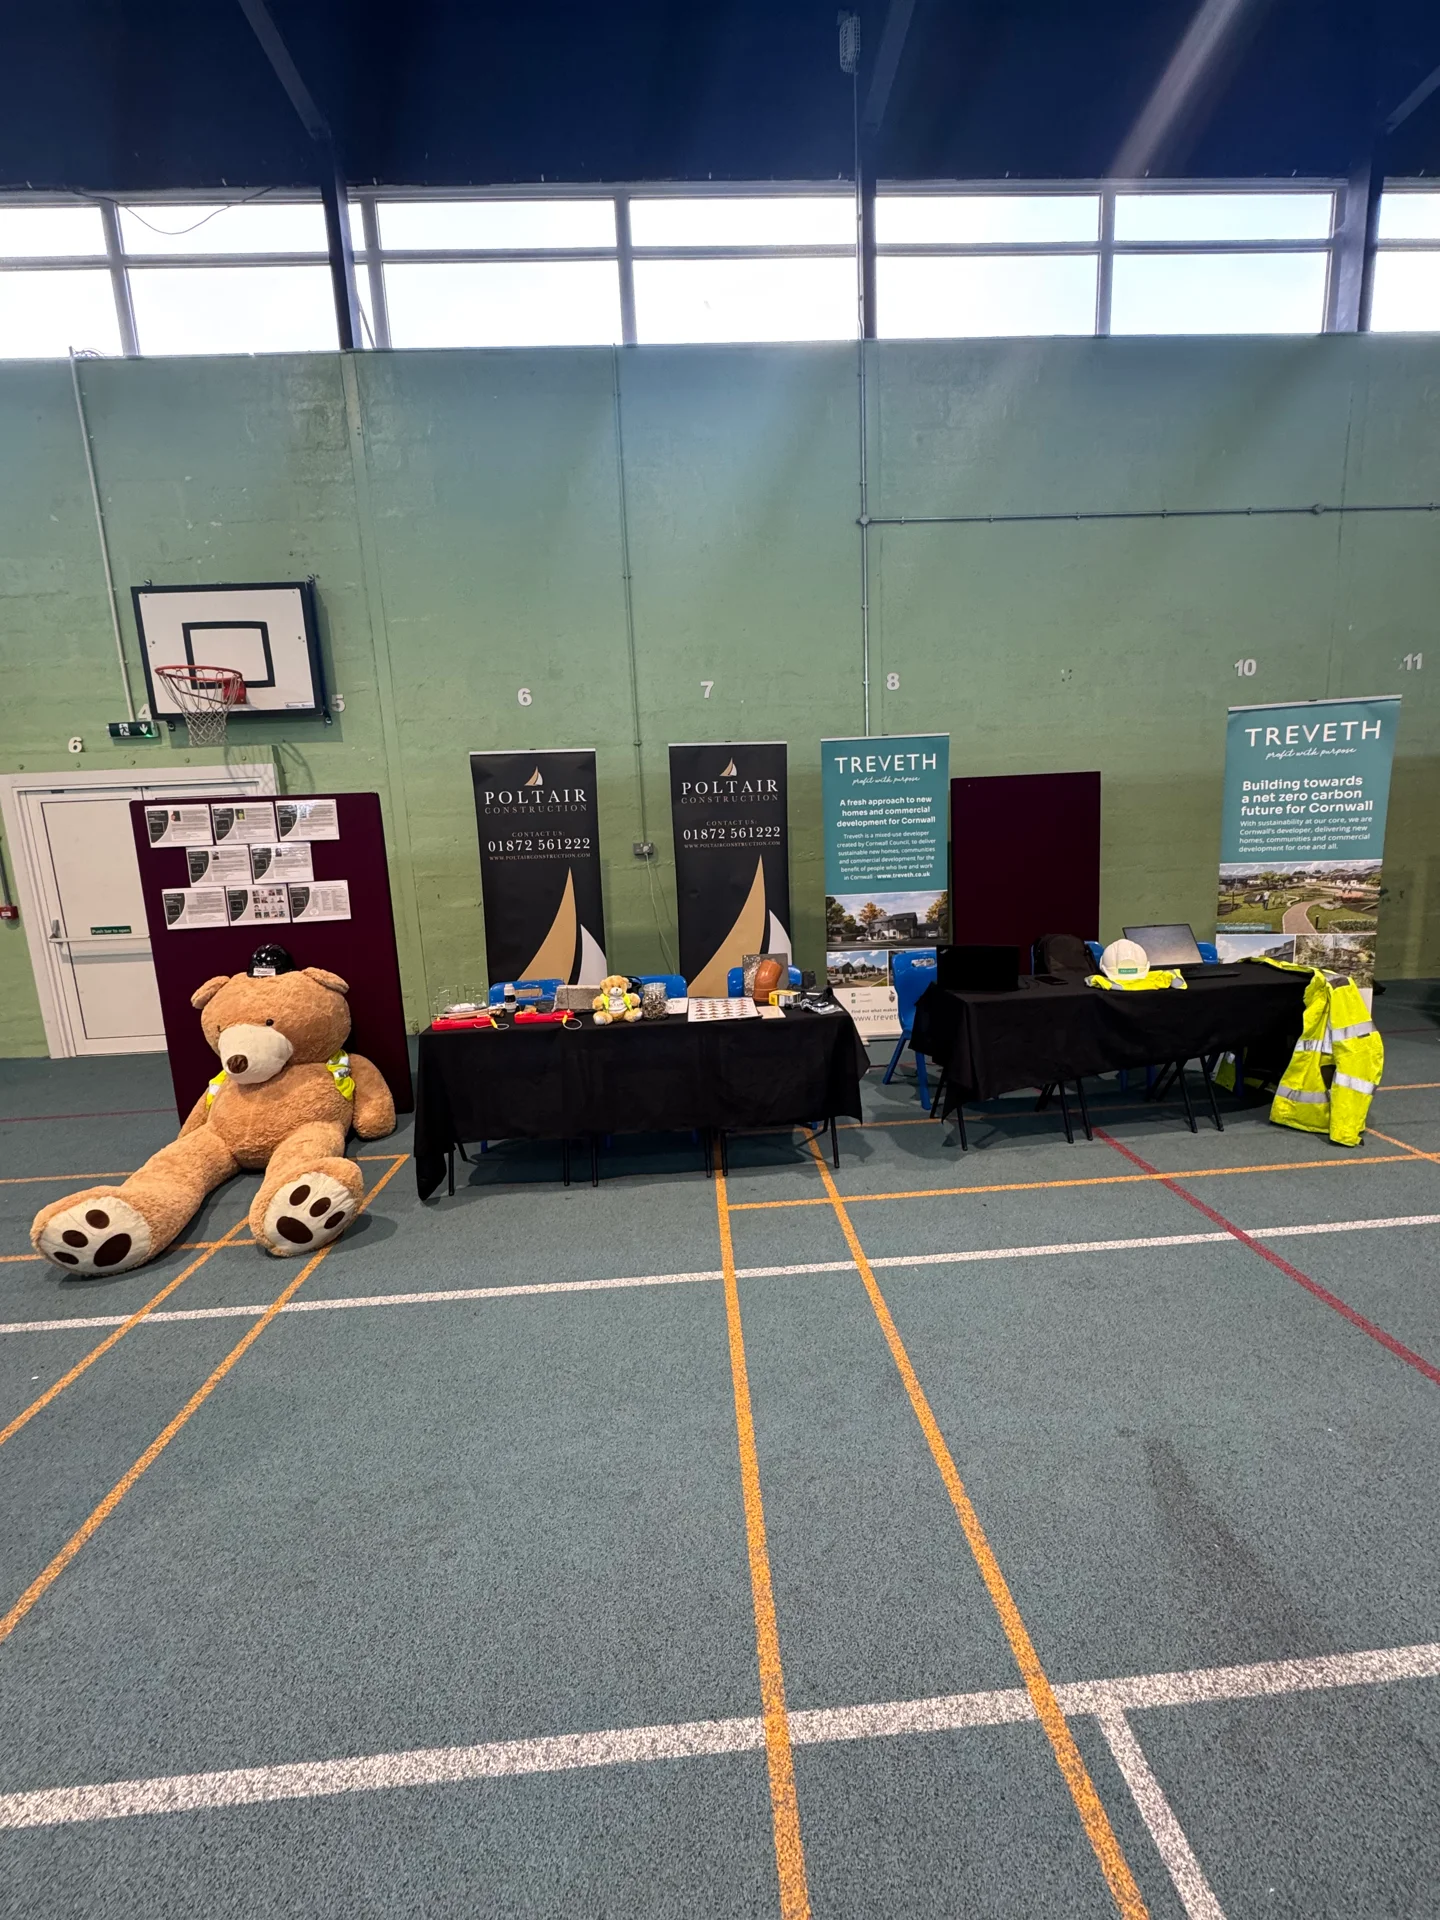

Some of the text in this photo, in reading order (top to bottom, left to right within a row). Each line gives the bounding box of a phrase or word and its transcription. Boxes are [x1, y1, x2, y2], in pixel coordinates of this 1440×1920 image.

[1234, 659, 1257, 676] 10
[1404, 653, 1423, 670] 11
[887, 672, 900, 690] 8
[701, 681, 714, 698] 7
[331, 694, 345, 712] 5
[518, 688, 532, 706] 6
[138, 704, 152, 720] 4
[1245, 720, 1381, 747] TREVETH
[68, 737, 82, 753] 6
[1266, 747, 1357, 760] profit with purpose
[835, 753, 936, 774] TREVETH
[682, 780, 778, 794] POLTAIR
[852, 777, 874, 786] profit
[893, 776, 920, 784] purpose
[1243, 776, 1362, 791] Building towards
[485, 789, 587, 804] POLTAIR
[681, 795, 778, 804] CONSTRUCTION
[868, 797, 905, 806] approach
[1242, 789, 1362, 804] a net zero carbon
[485, 805, 587, 814] CONSTRUCTION
[869, 808, 883, 816] and
[885, 806, 930, 815] commercial
[1241, 800, 1373, 816] future for Cornwall
[837, 818, 887, 828] development
[901, 816, 936, 824] Cornwall
[1258, 818, 1303, 826] sustainability
[684, 826, 780, 840] 01872 561222
[1276, 827, 1313, 835] developer,
[1315, 825, 1350, 833] delivering
[488, 838, 590, 852] 01872 561222
[1266, 835, 1310, 843] communities
[1239, 845, 1284, 853] development
